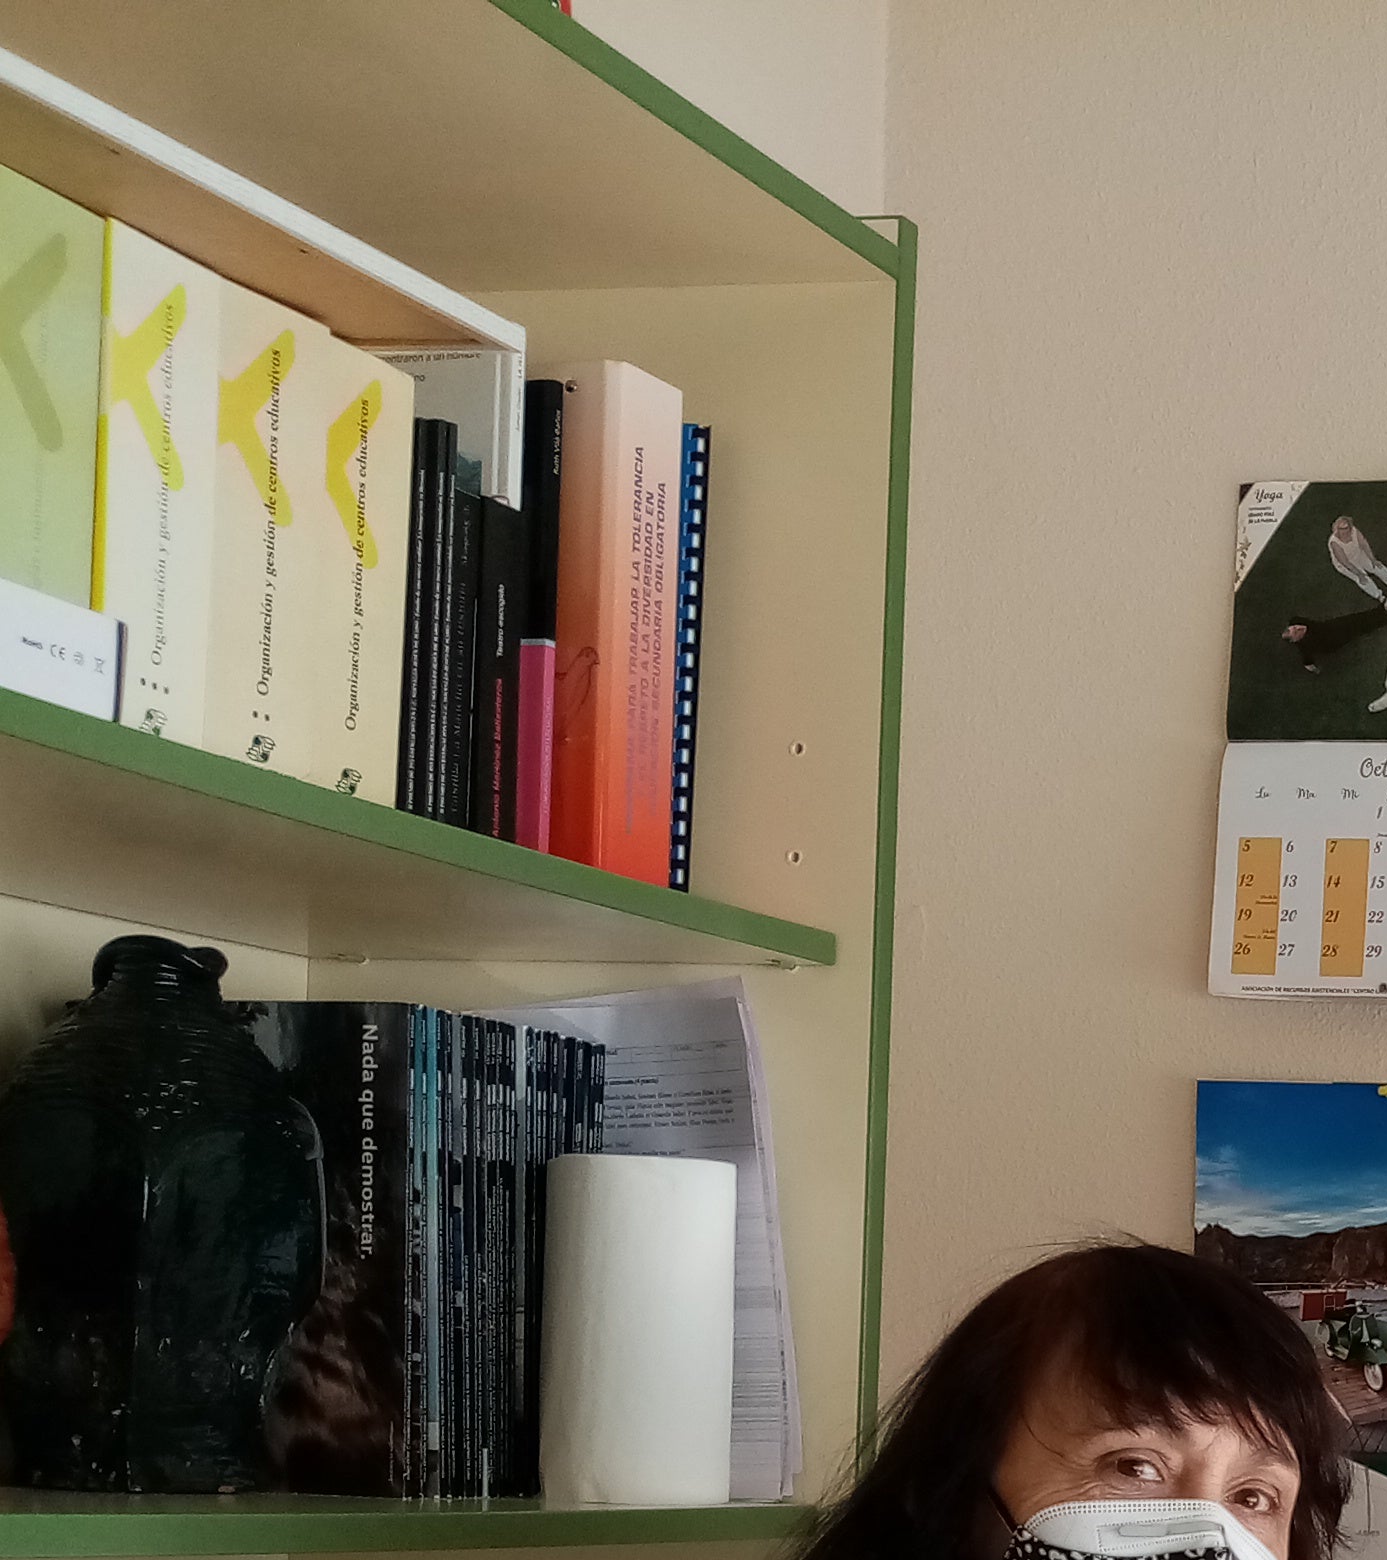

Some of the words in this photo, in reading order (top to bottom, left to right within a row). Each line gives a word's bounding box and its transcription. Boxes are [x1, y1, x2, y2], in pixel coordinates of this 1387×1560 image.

[266, 348, 281, 433] educativos
[162, 397, 173, 452] centros
[355, 399, 370, 478] educativos
[158, 457, 171, 476] de
[267, 436, 279, 495] centros
[159, 481, 171, 541] gestión
[263, 496, 278, 516] de
[356, 482, 367, 537] centros
[632, 446, 645, 553] TOLERANCIA
[645, 490, 655, 517] EN
[1255, 489, 1283, 503] Yoga
[159, 544, 169, 555] y
[263, 520, 278, 577] gestión
[352, 540, 364, 559] de
[654, 482, 666, 593] OBLIGATORIA
[265, 580, 277, 591] y
[352, 562, 364, 618] gestión
[632, 560, 642, 581] LA
[642, 522, 654, 627] DIVERSIDAD
[256, 593, 274, 697] Organización
[353, 619, 364, 630] y
[629, 587, 641, 675] TRABAJAR
[641, 633, 651, 654] LA
[344, 632, 361, 731] Organización
[1376, 806, 1383, 819] 1
[1242, 840, 1251, 853] 5
[1286, 840, 1294, 853] 6
[1329, 840, 1338, 854] 7
[1373, 841, 1382, 854] 8
[1239, 874, 1254, 887] 12
[1282, 875, 1298, 888] 13
[1326, 875, 1341, 888] 14
[1370, 876, 1386, 889] 15
[1237, 908, 1252, 921] 19
[1280, 909, 1298, 922] 20
[1324, 910, 1340, 923] 21
[1367, 911, 1385, 924] 22
[1234, 943, 1251, 956] 26
[1278, 944, 1295, 957] 27
[1321, 944, 1339, 958] 28
[1365, 945, 1383, 958] 29
[361, 1024, 379, 1083] Nada
[358, 1088, 375, 1130] que
[360, 1136, 379, 1260] demostrar.
